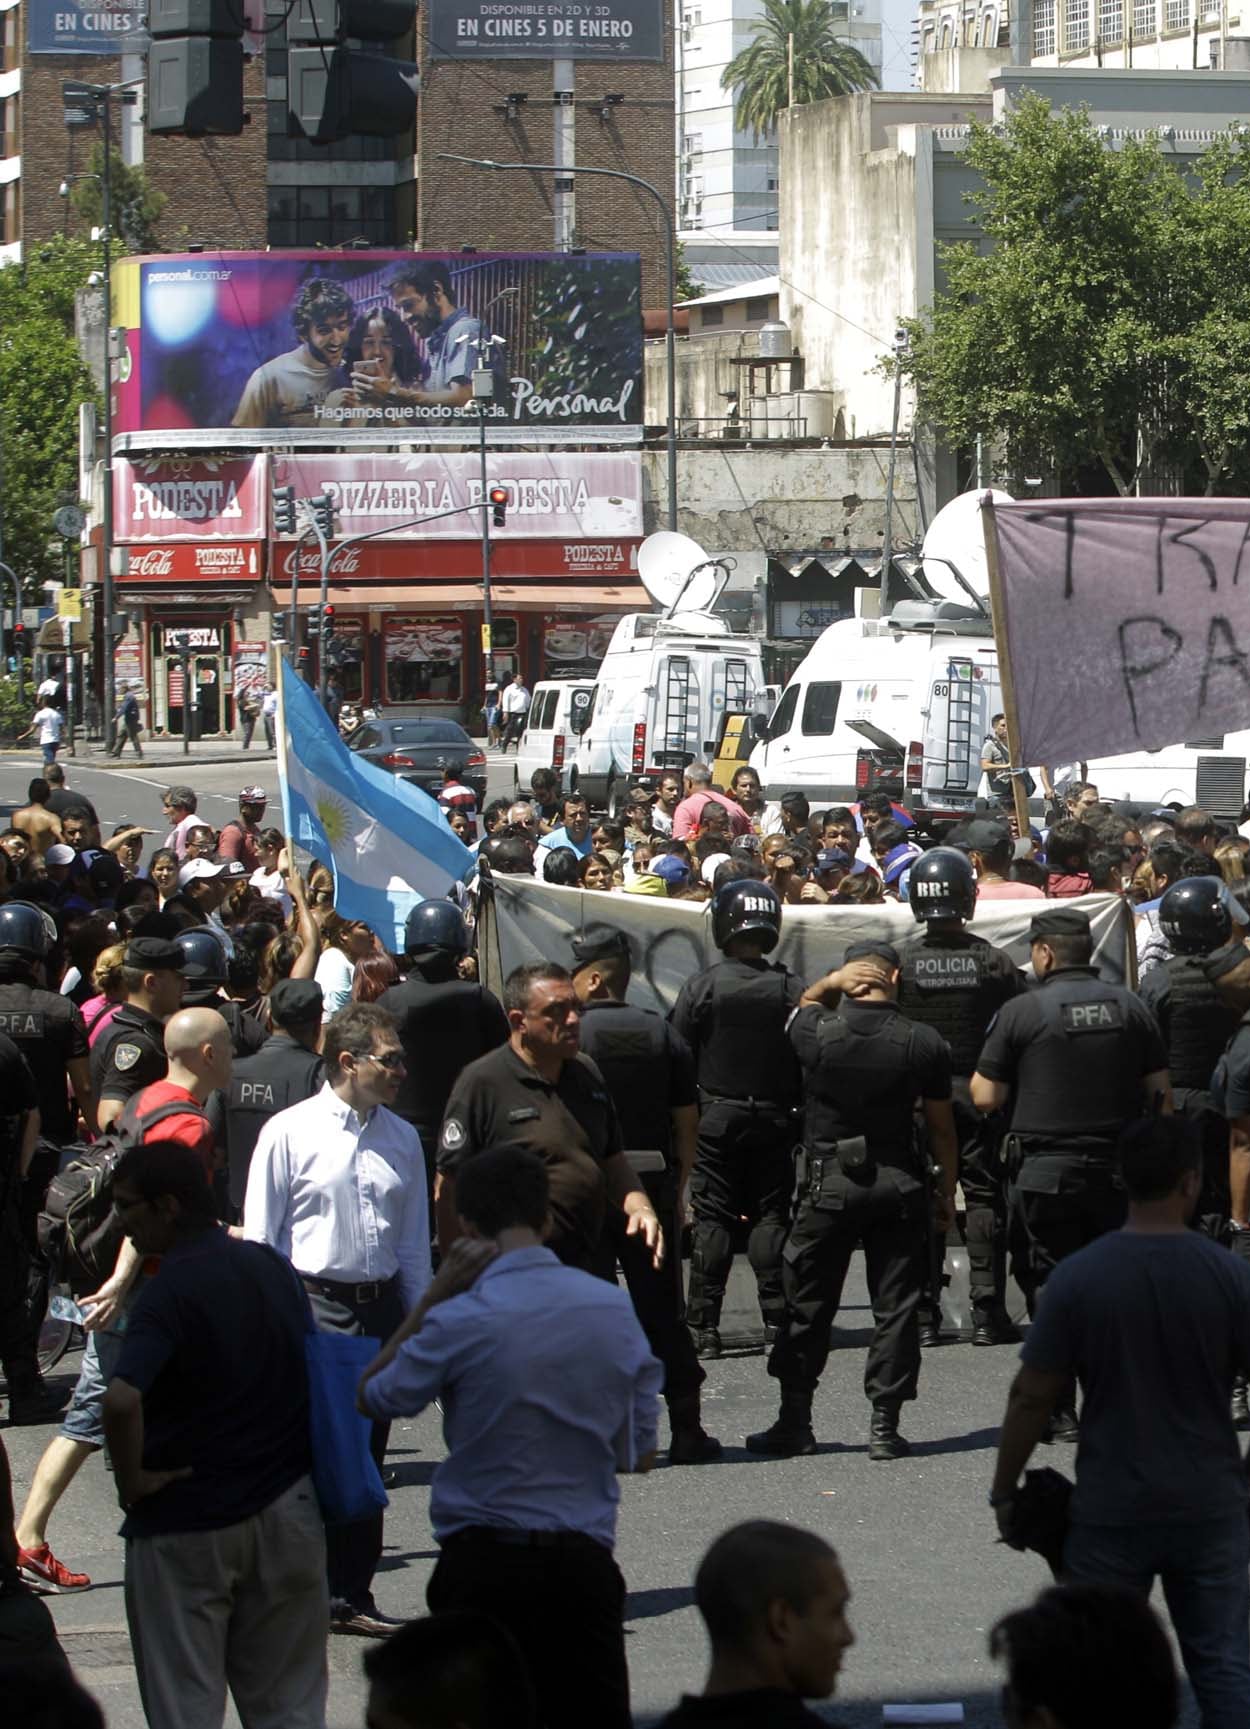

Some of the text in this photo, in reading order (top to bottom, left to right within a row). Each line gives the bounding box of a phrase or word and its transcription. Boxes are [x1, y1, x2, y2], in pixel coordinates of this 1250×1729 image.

[480, 5, 610, 17] DISPONIBLE EN 2D Y 3D
[55, 13, 76, 31] EN
[83, 13, 131, 31] CINES
[457, 19, 633, 38] EN CINES 5 DE ENERO
[510, 377, 635, 422] Personal
[314, 404, 383, 422] Hagamos
[384, 409, 414, 421] que
[415, 404, 451, 418] todo
[132, 480, 243, 520] PODESTA
[320, 480, 590, 516] PIZZERIA PDESTA
[195, 548, 246, 566] PODESTA
[563, 545, 625, 562] PODESTA
[165, 628, 220, 647] POESTA
[577, 695, 588, 705] 90
[934, 685, 949, 697] 80
[916, 958, 977, 975] POLICIA
[1071, 1004, 1112, 1027] PFA
[241, 1083, 274, 1105] PFA
